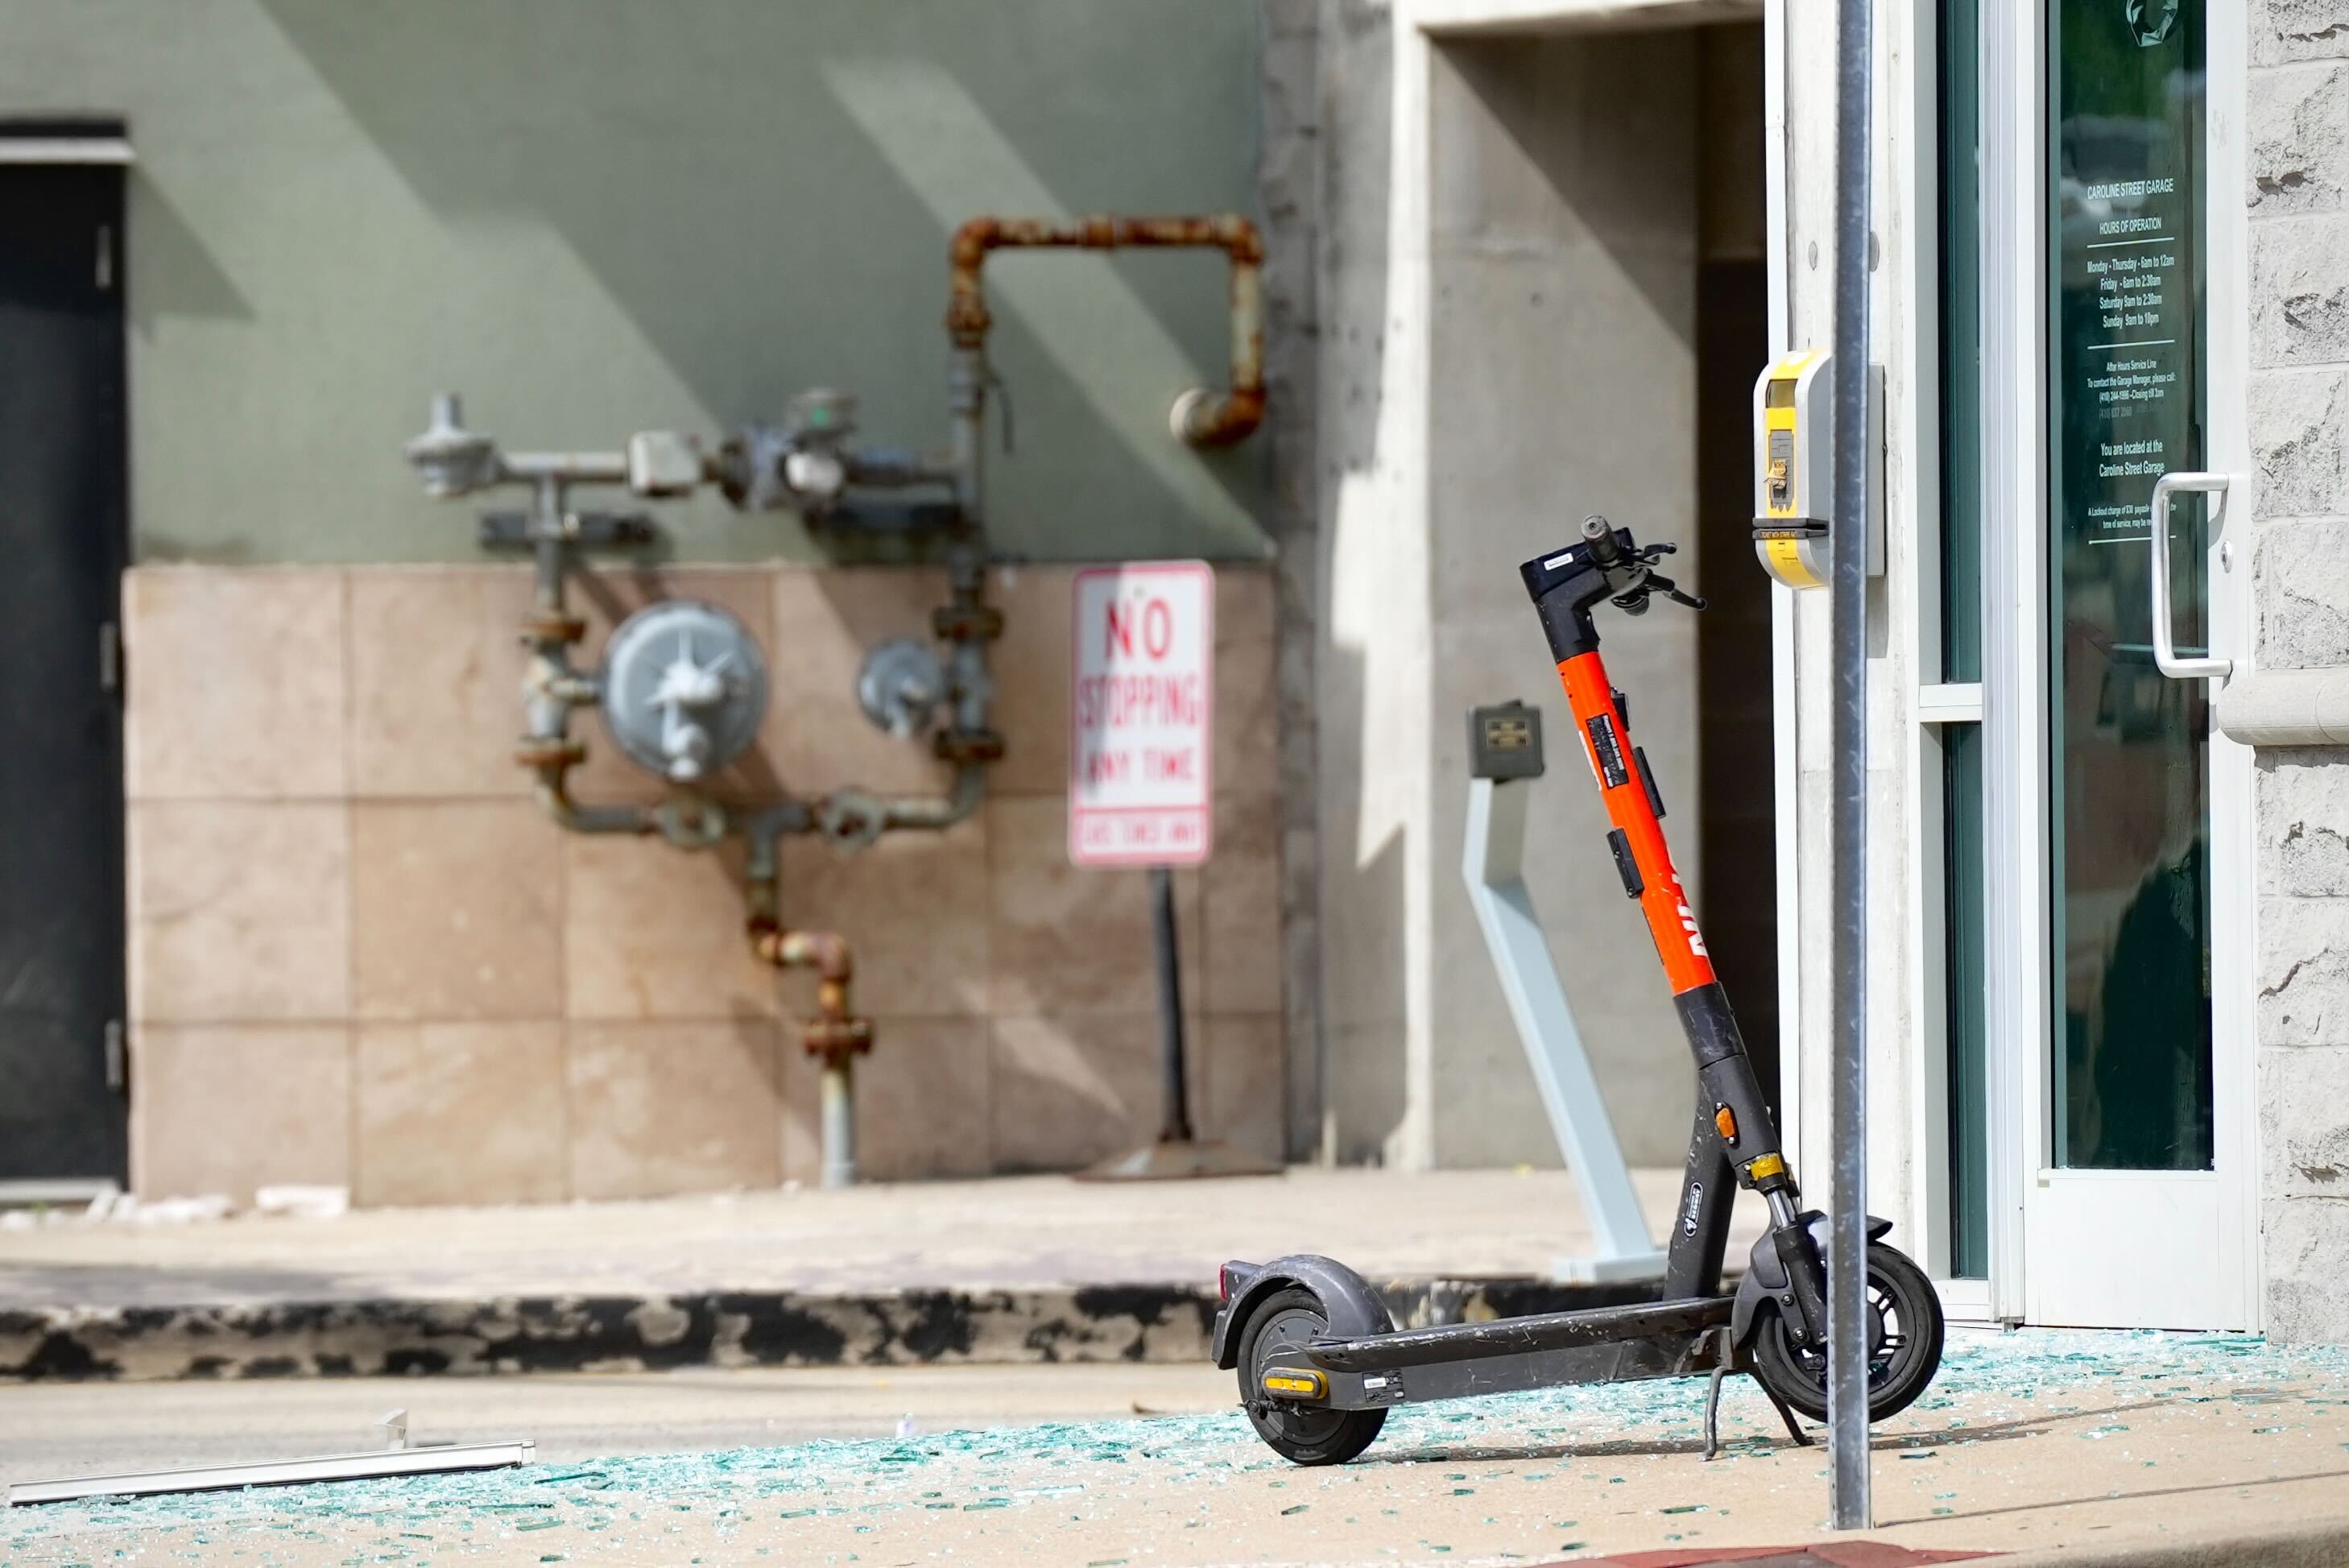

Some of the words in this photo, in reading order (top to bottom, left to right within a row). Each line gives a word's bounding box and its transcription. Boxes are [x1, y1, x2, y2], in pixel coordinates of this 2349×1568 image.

[2087, 183, 2119, 200] CAROLINE
[2120, 180, 2145, 196] STREET
[2146, 178, 2174, 194] GARAGE
[2099, 221, 2119, 234] HOURS
[2120, 220, 2128, 233] OF
[2129, 217, 2161, 232] OPERATION
[2087, 260, 2108, 274] Monday
[2111, 258, 2137, 272] Thursday
[2153, 256, 2159, 267] to
[2100, 278, 2117, 292] Friday
[2135, 277, 2141, 288] to
[2099, 296, 2123, 311] Saturday
[2136, 295, 2142, 306] to
[2103, 315, 2123, 329] Sunday
[2138, 313, 2144, 325] to
[2131, 359, 2146, 370] Service
[2101, 443, 2112, 456] You
[2113, 444, 2123, 456] are
[2124, 441, 2145, 454] located
[2146, 441, 2153, 453] at
[2153, 439, 2163, 453] the
[2099, 464, 2124, 477] Caroline
[2124, 461, 2142, 475] Street
[2143, 460, 2165, 477] Garage
[1106, 598, 1172, 660] NO
[1080, 675, 1198, 727] STOPPING
[1088, 748, 1131, 783] ANY
[1144, 747, 1196, 782] TIME
